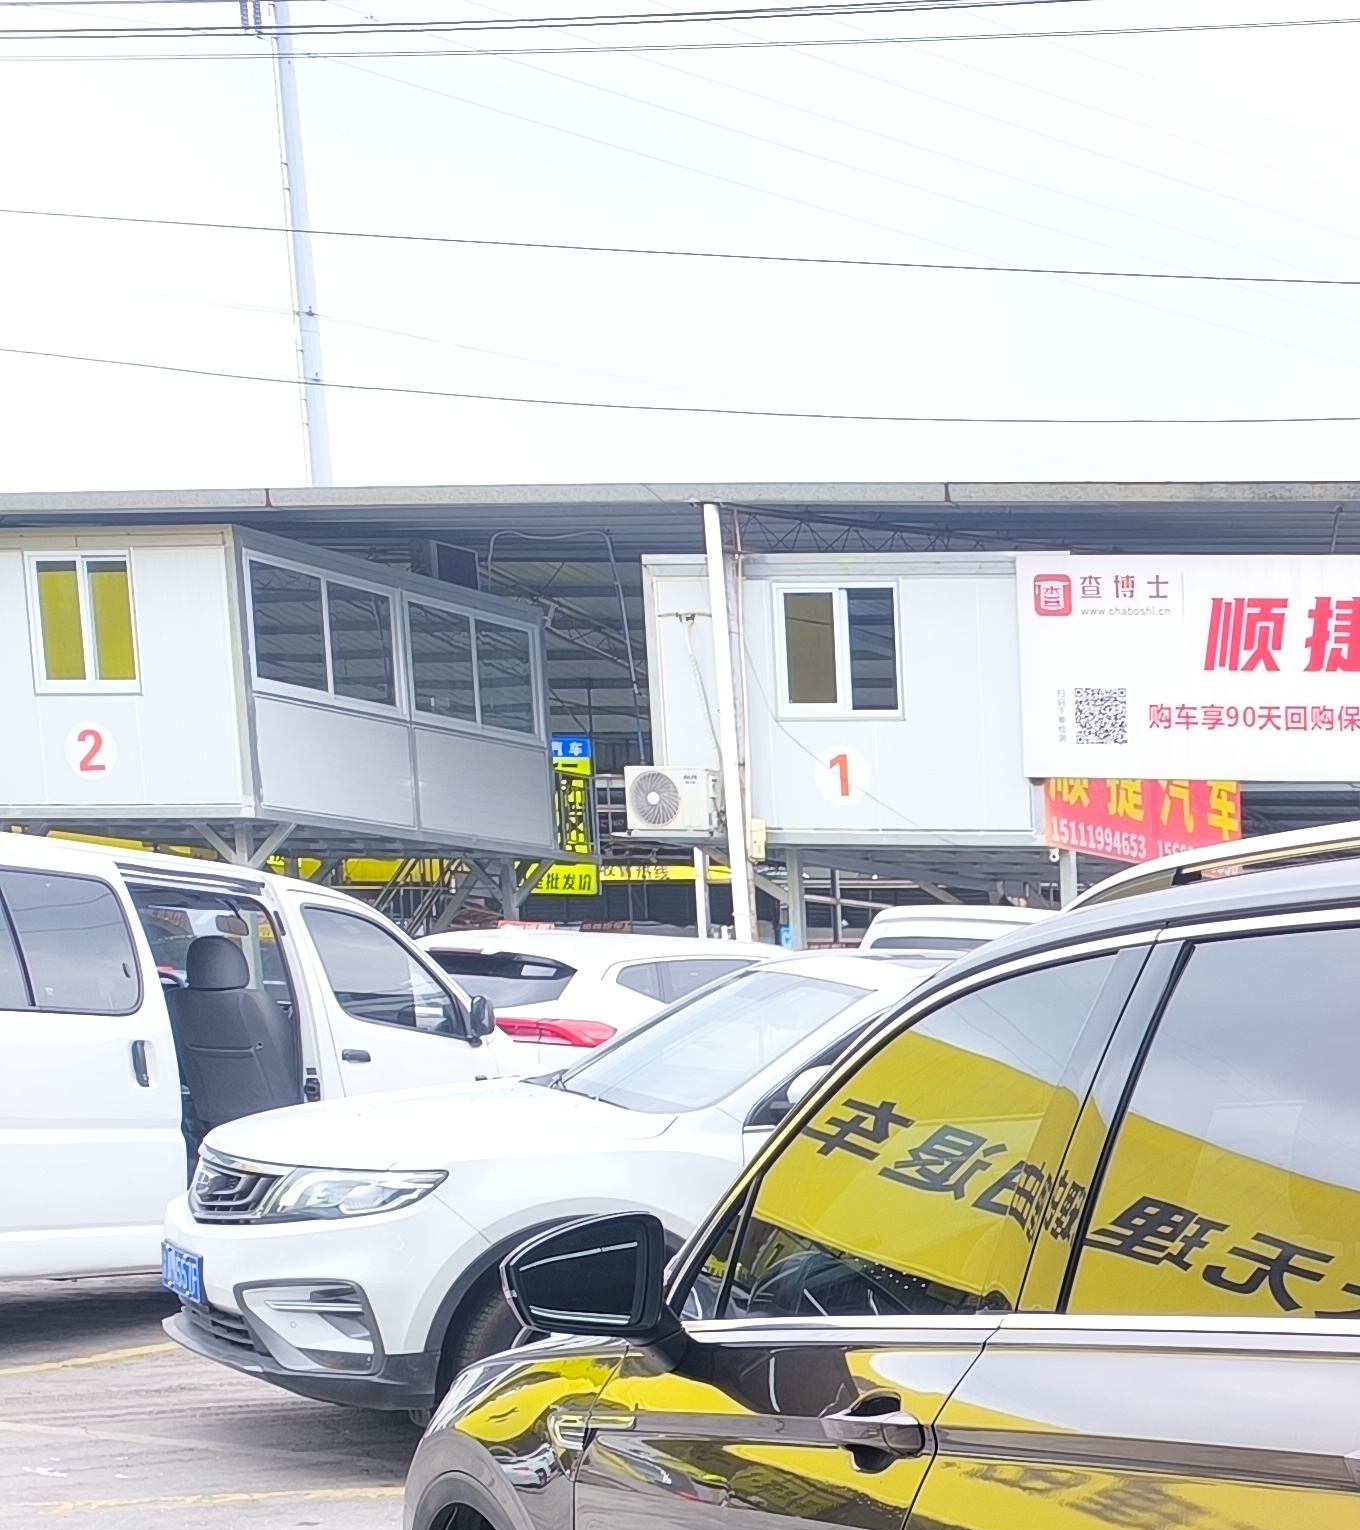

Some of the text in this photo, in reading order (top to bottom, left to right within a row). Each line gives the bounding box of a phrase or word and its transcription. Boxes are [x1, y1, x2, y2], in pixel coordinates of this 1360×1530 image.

[1079, 574, 1170, 599] 查博士
[1080, 606, 1171, 617] www.chaboshi.cn
[76, 729, 107, 772] 2
[829, 753, 850, 797] 1
[1049, 816, 1148, 859] 15111994653
